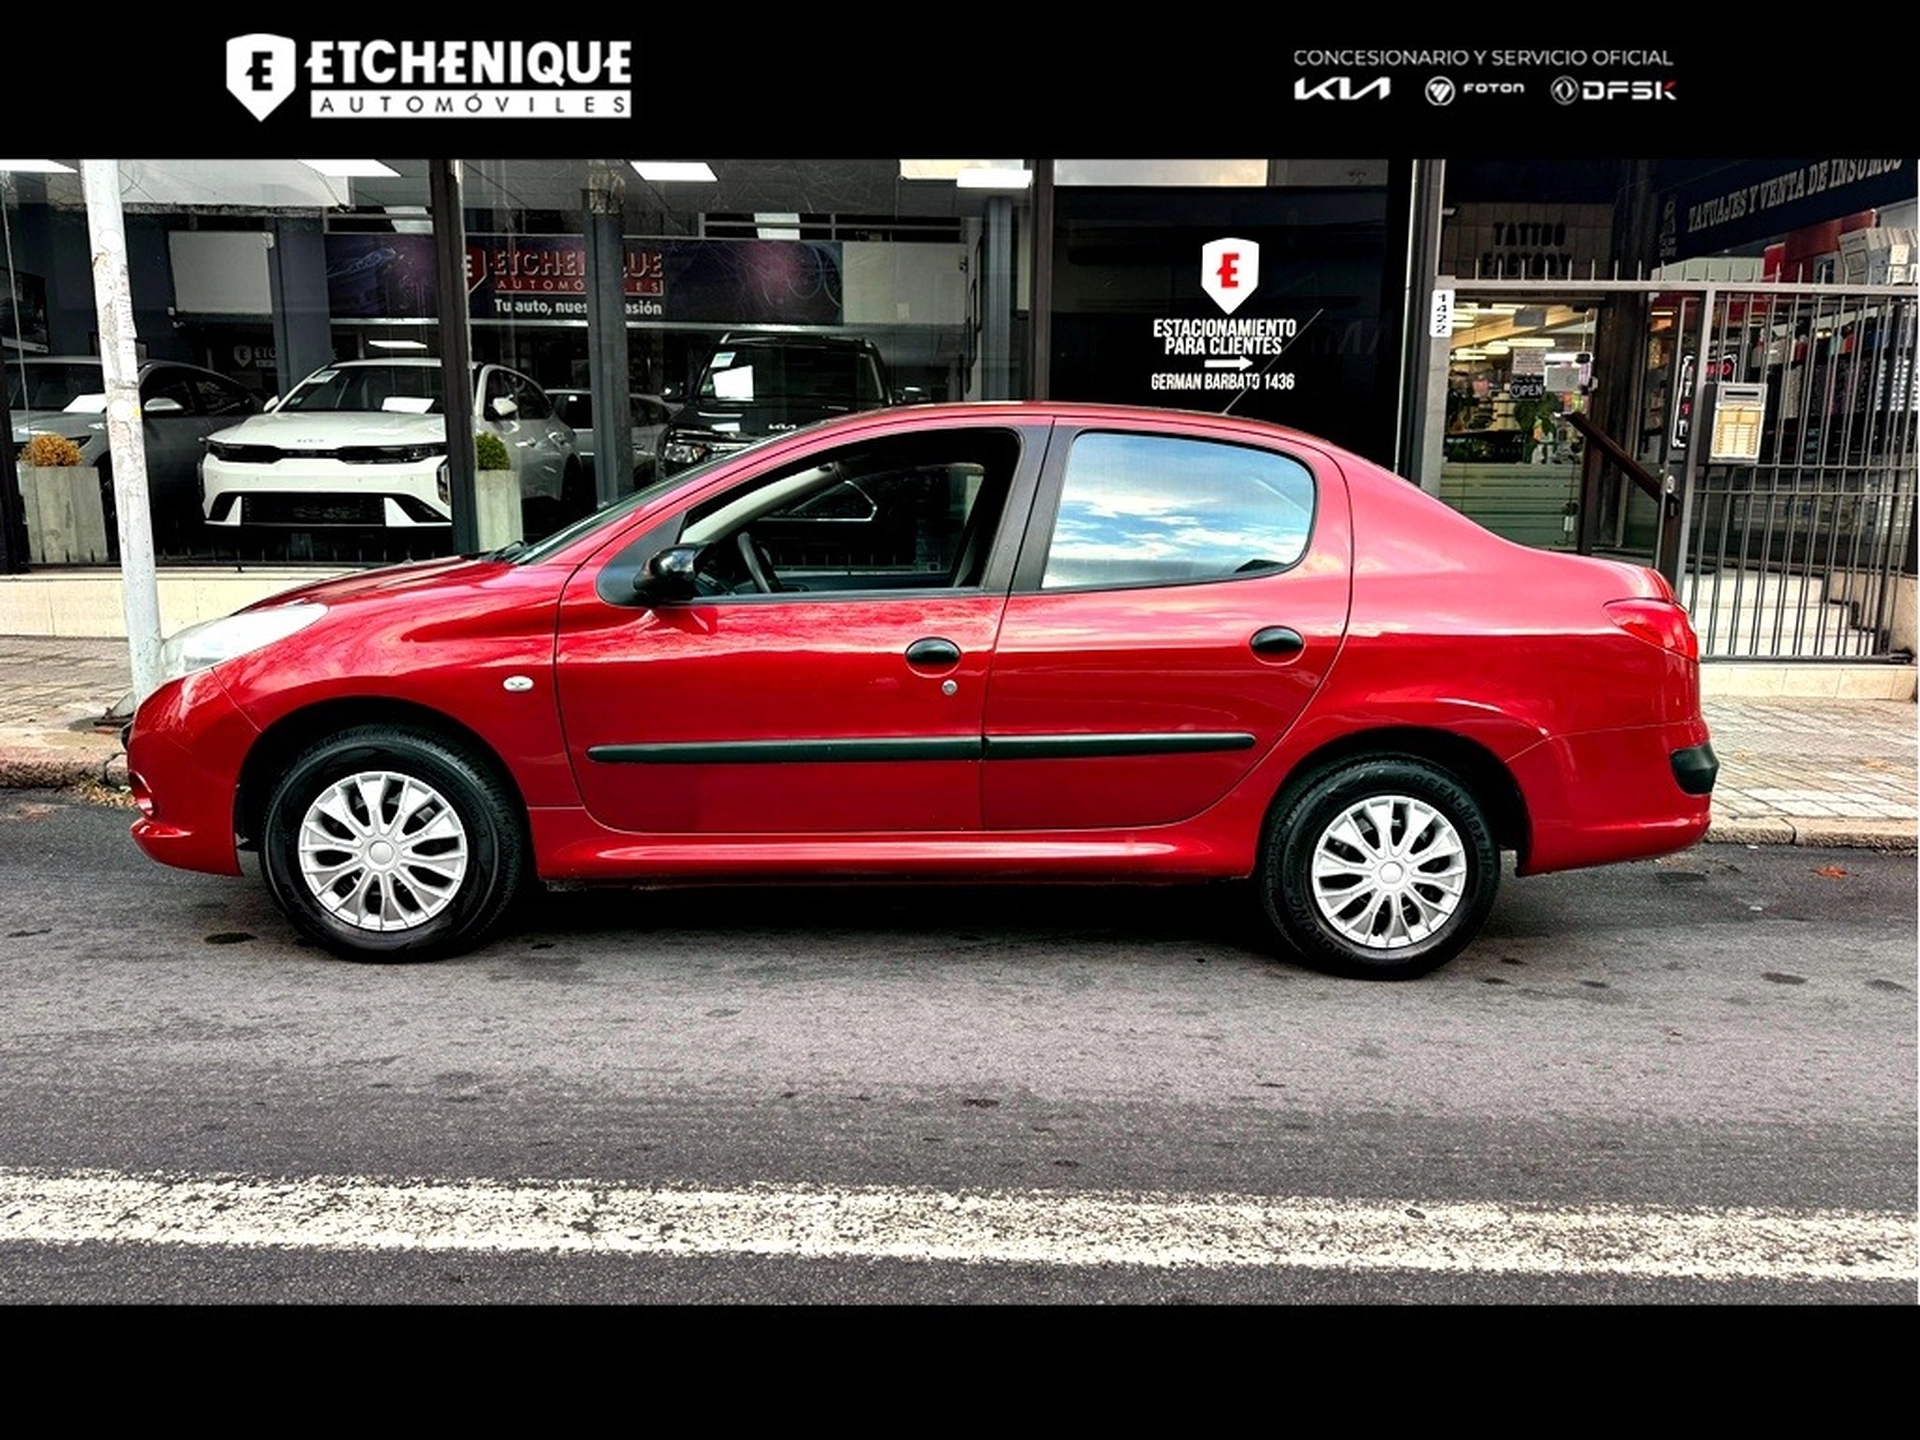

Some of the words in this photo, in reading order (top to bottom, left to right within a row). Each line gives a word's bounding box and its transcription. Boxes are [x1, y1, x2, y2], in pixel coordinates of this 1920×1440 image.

[1687, 188, 1749, 233] TATUAJES
[1748, 183, 1760, 214] Y
[1760, 167, 1805, 211] VENTA
[1806, 160, 1829, 197] DE
[1493, 222, 1566, 246] TATTOO
[490, 250, 663, 278] ETCHEUE
[494, 299, 512, 312] Tu
[514, 300, 552, 315] auto,
[624, 302, 662, 315] asión
[1436, 293, 1447, 334] 1422
[1153, 318, 1297, 338] ESTACIONAMIENTO
[1165, 337, 1206, 355] PARA
[1210, 336, 1283, 355] CLIENTES
[1151, 373, 1202, 390] GERMAN
[1204, 373, 1260, 390] BARBATO
[1265, 373, 1295, 390] 1436
